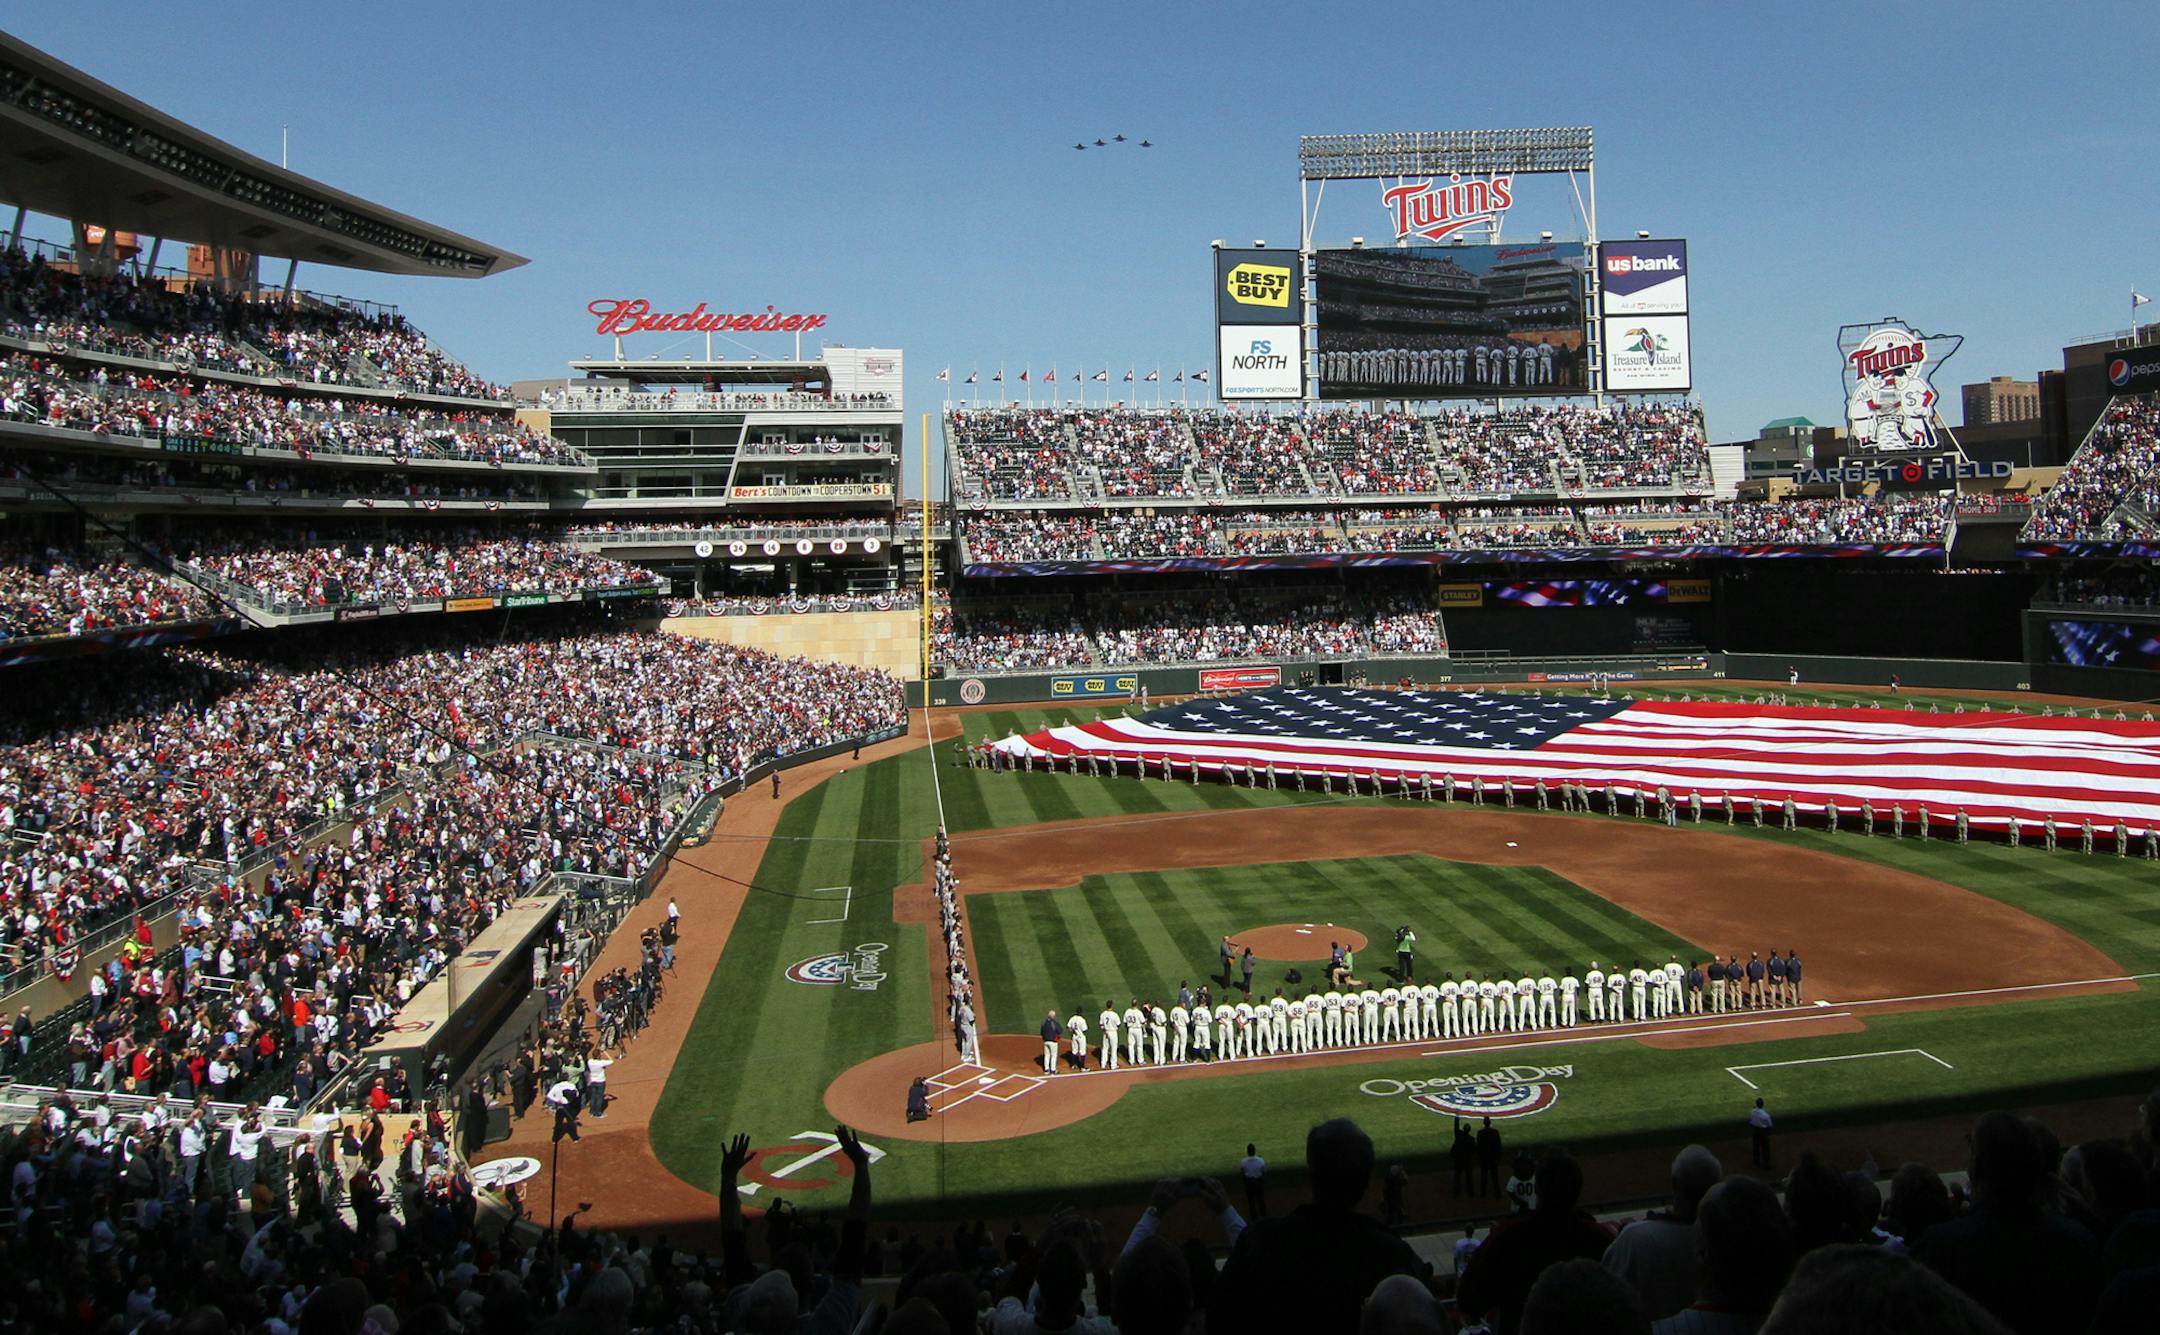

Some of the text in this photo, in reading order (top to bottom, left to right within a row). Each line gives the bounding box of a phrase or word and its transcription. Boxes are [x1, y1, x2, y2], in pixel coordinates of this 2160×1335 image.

[1383, 174, 1513, 239] Twins
[1236, 271, 1288, 287] BEST
[1237, 285, 1283, 300] BUY
[588, 299, 828, 335] Budweiser
[1250, 340, 1272, 354] FS
[1232, 355, 1288, 370] NORTH
[1612, 352, 1682, 366] Treasure Island
[1849, 342, 1924, 380] Twins
[1793, 461, 2012, 484] TARGET FIELD
[734, 486, 767, 497] Bert's
[768, 485, 812, 497] COUNTDOWN
[820, 484, 872, 496] COOPERSTOWN
[873, 484, 887, 495] 51
[1958, 506, 1981, 514] THOME
[767, 544, 776, 552] 14
[870, 542, 875, 550] 3
[1443, 591, 1478, 600] STANLEY
[1547, 673, 1569, 681] Getting
[1407, 991, 1416, 1000] 47
[1426, 992, 1434, 1000] 41
[1359, 1064, 1573, 1096] Opening Day
